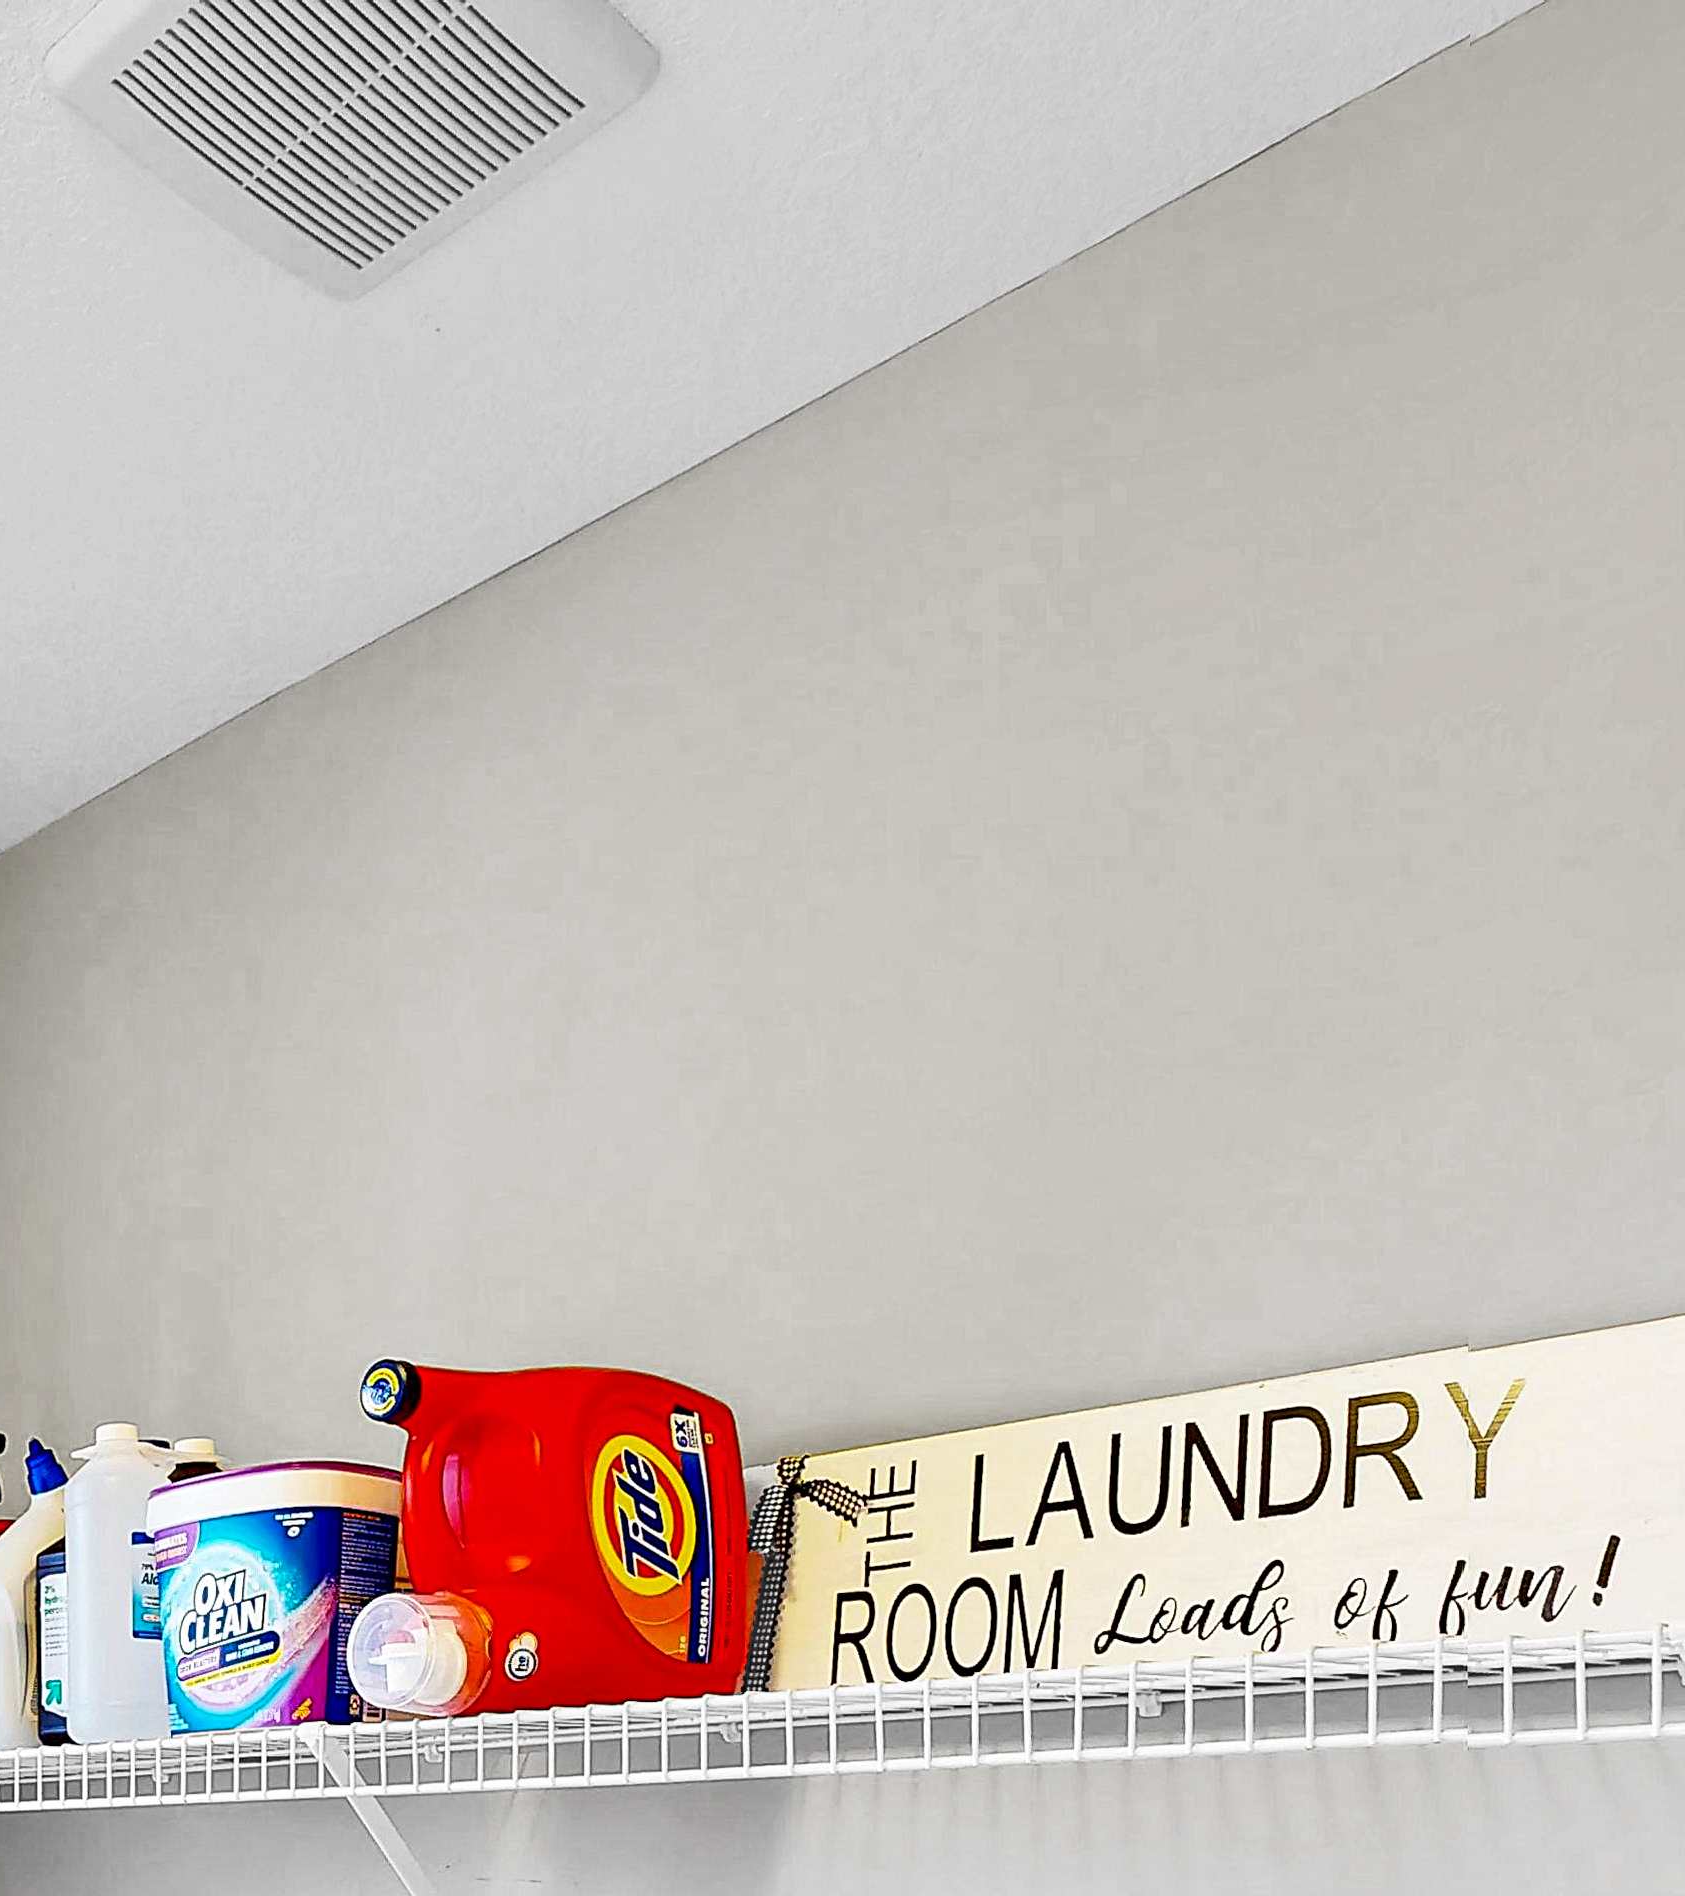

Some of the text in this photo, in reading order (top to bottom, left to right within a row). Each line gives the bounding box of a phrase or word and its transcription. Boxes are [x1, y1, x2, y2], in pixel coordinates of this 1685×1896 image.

[611, 1446, 683, 1586] Tide
[864, 1460, 917, 1587] THE
[969, 1377, 1527, 1552] LAUNDRY
[180, 1594, 267, 1655] CLEAN
[194, 1569, 246, 1616] OXI
[697, 1577, 710, 1657] ORIGINAL
[830, 1569, 1065, 1686] ROOM
[1093, 1559, 1294, 1655] Loads
[1333, 1569, 1409, 1643] of
